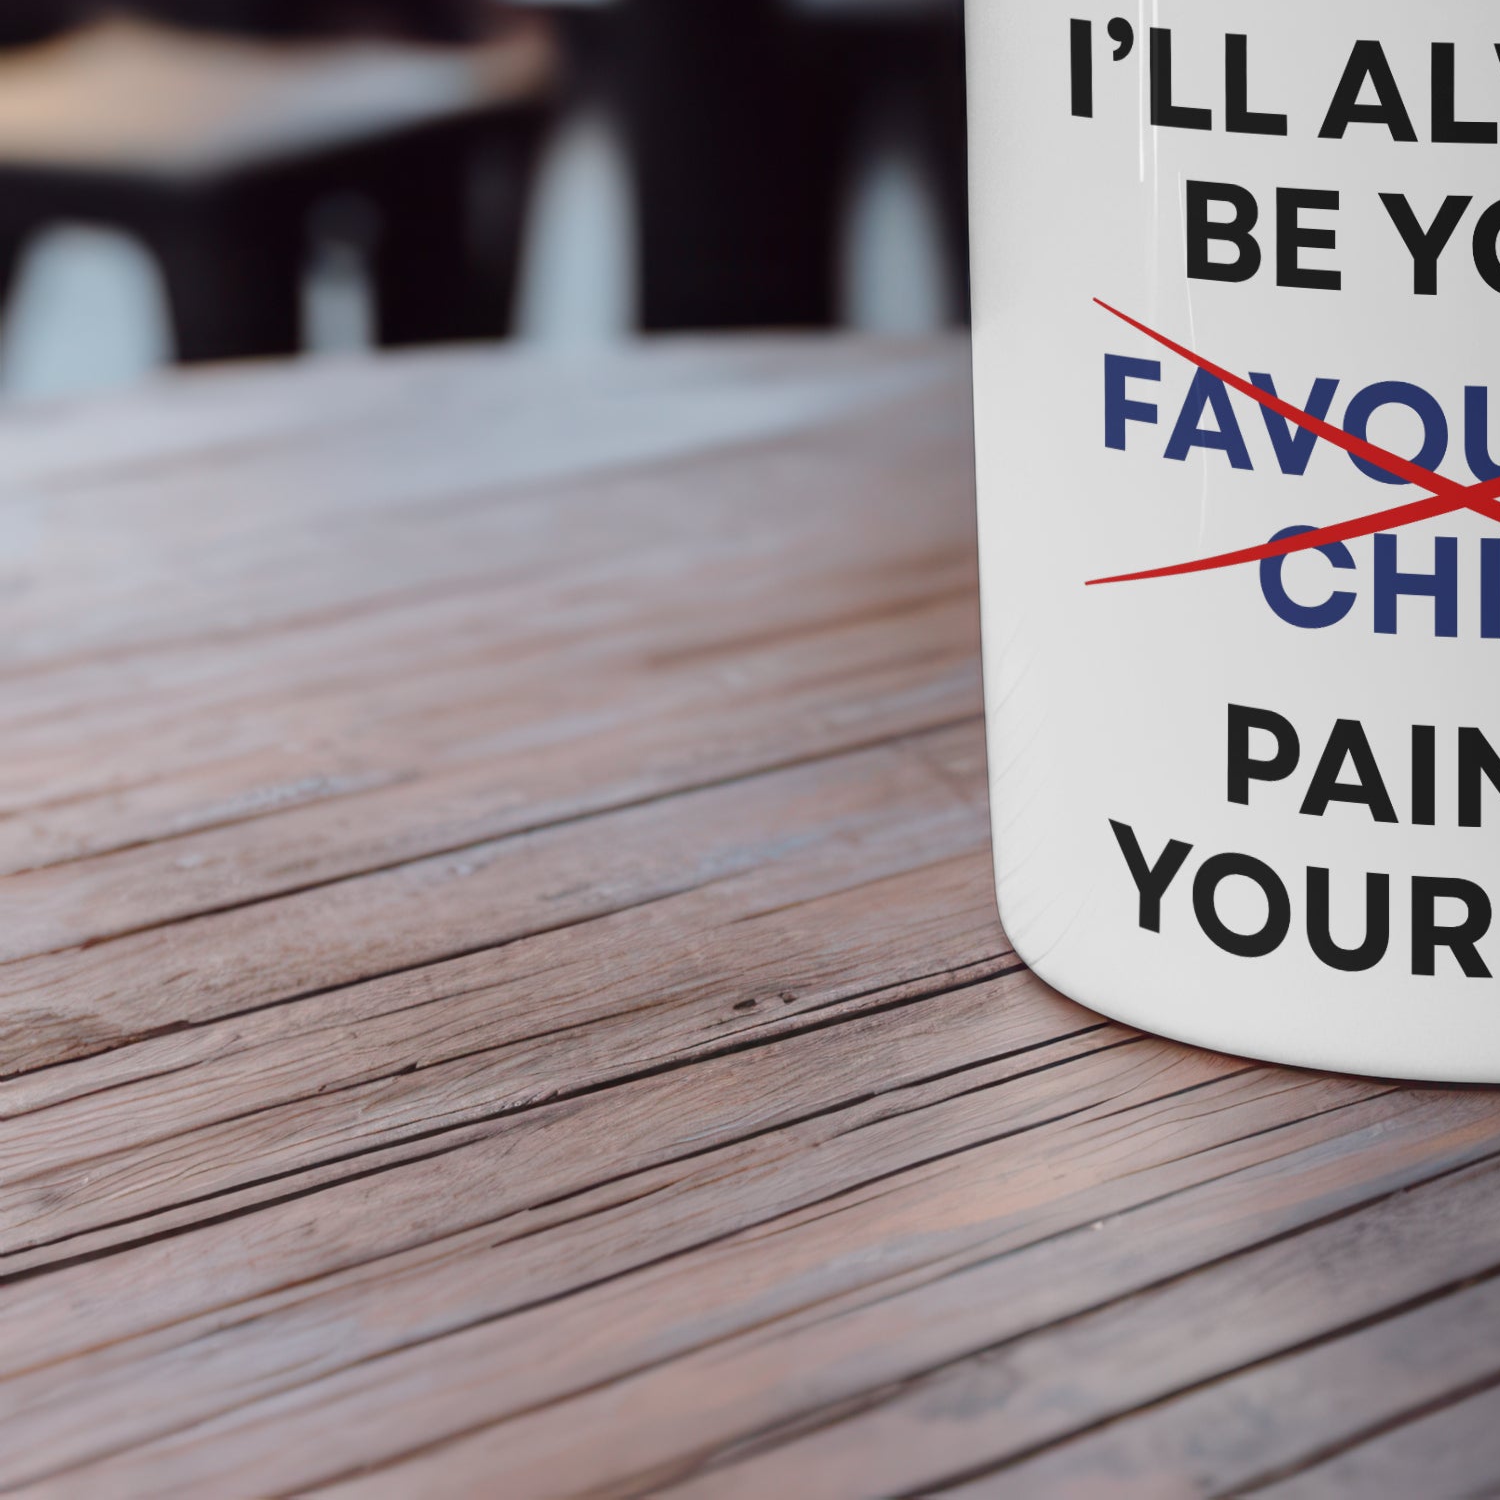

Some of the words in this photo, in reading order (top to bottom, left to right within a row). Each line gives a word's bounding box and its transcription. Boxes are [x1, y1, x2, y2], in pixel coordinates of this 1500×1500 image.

[1069, 17, 1289, 138] I’LL
[1185, 178, 1343, 292] BE
[1107, 817, 1494, 980] YOUR
